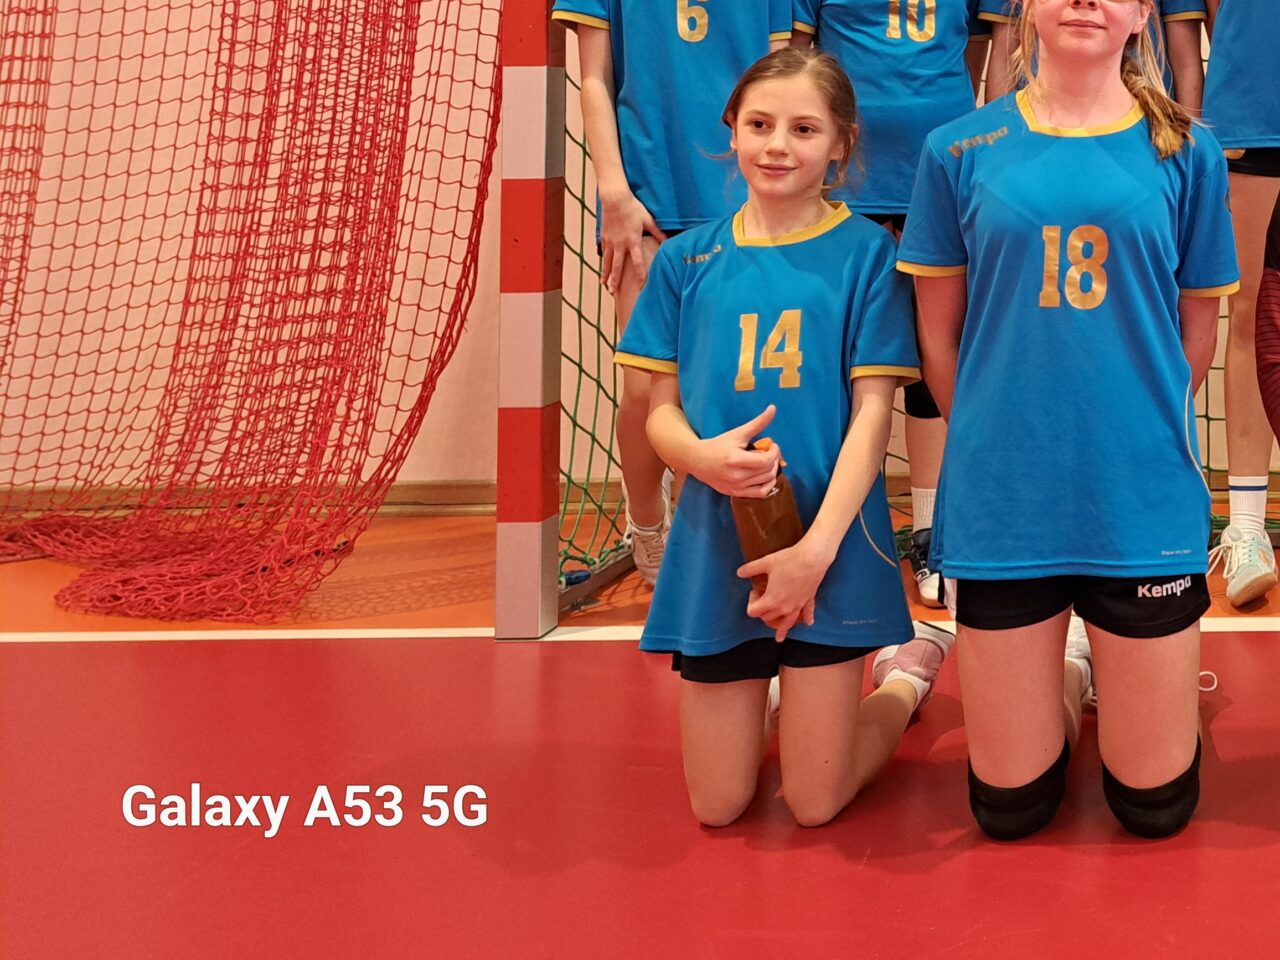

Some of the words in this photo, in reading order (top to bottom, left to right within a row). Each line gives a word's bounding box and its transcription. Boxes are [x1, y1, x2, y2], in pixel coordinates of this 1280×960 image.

[1039, 224, 1110, 310] 18
[734, 308, 803, 391] 14
[1138, 575, 1192, 598] Kempa
